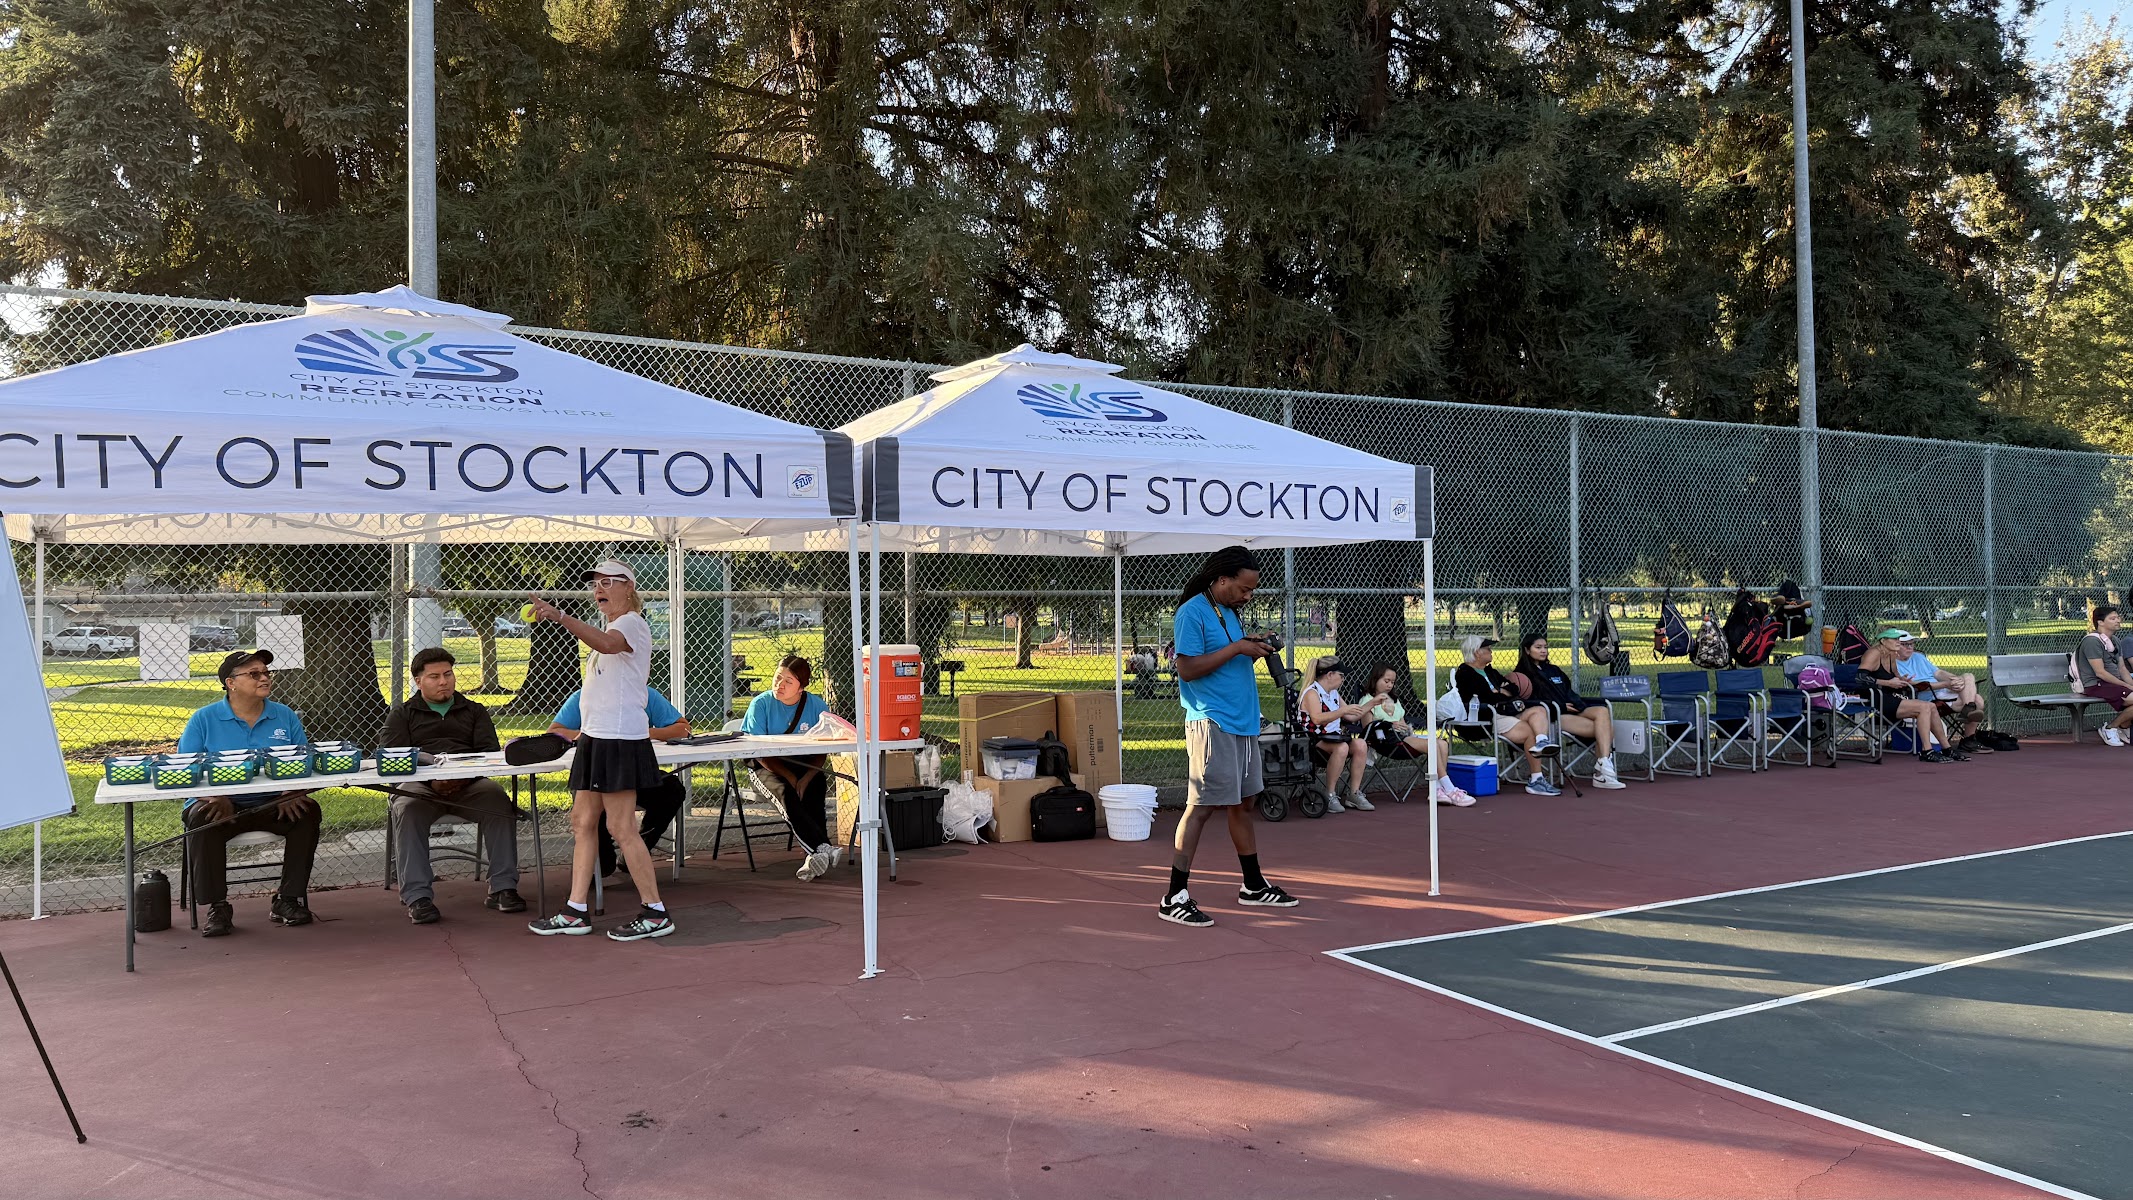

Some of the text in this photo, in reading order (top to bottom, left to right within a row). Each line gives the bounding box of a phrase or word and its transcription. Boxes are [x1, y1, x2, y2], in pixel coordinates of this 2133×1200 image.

[289, 373, 544, 396] CITY OF STOCKTON
[300, 383, 543, 406] RECREATION
[223, 389, 616, 418] COMMUNITY GROWS HERE
[1041, 418, 1198, 432] CITY OF STOCKTON
[1056, 427, 1208, 441] RECREATION
[1025, 433, 1138, 446] COMMUNITY
[0, 432, 763, 499] CITY OF STOCKTON
[931, 466, 1379, 523] CITY OF STOCKTON
[1736, 630, 1755, 654] GEARBOX
